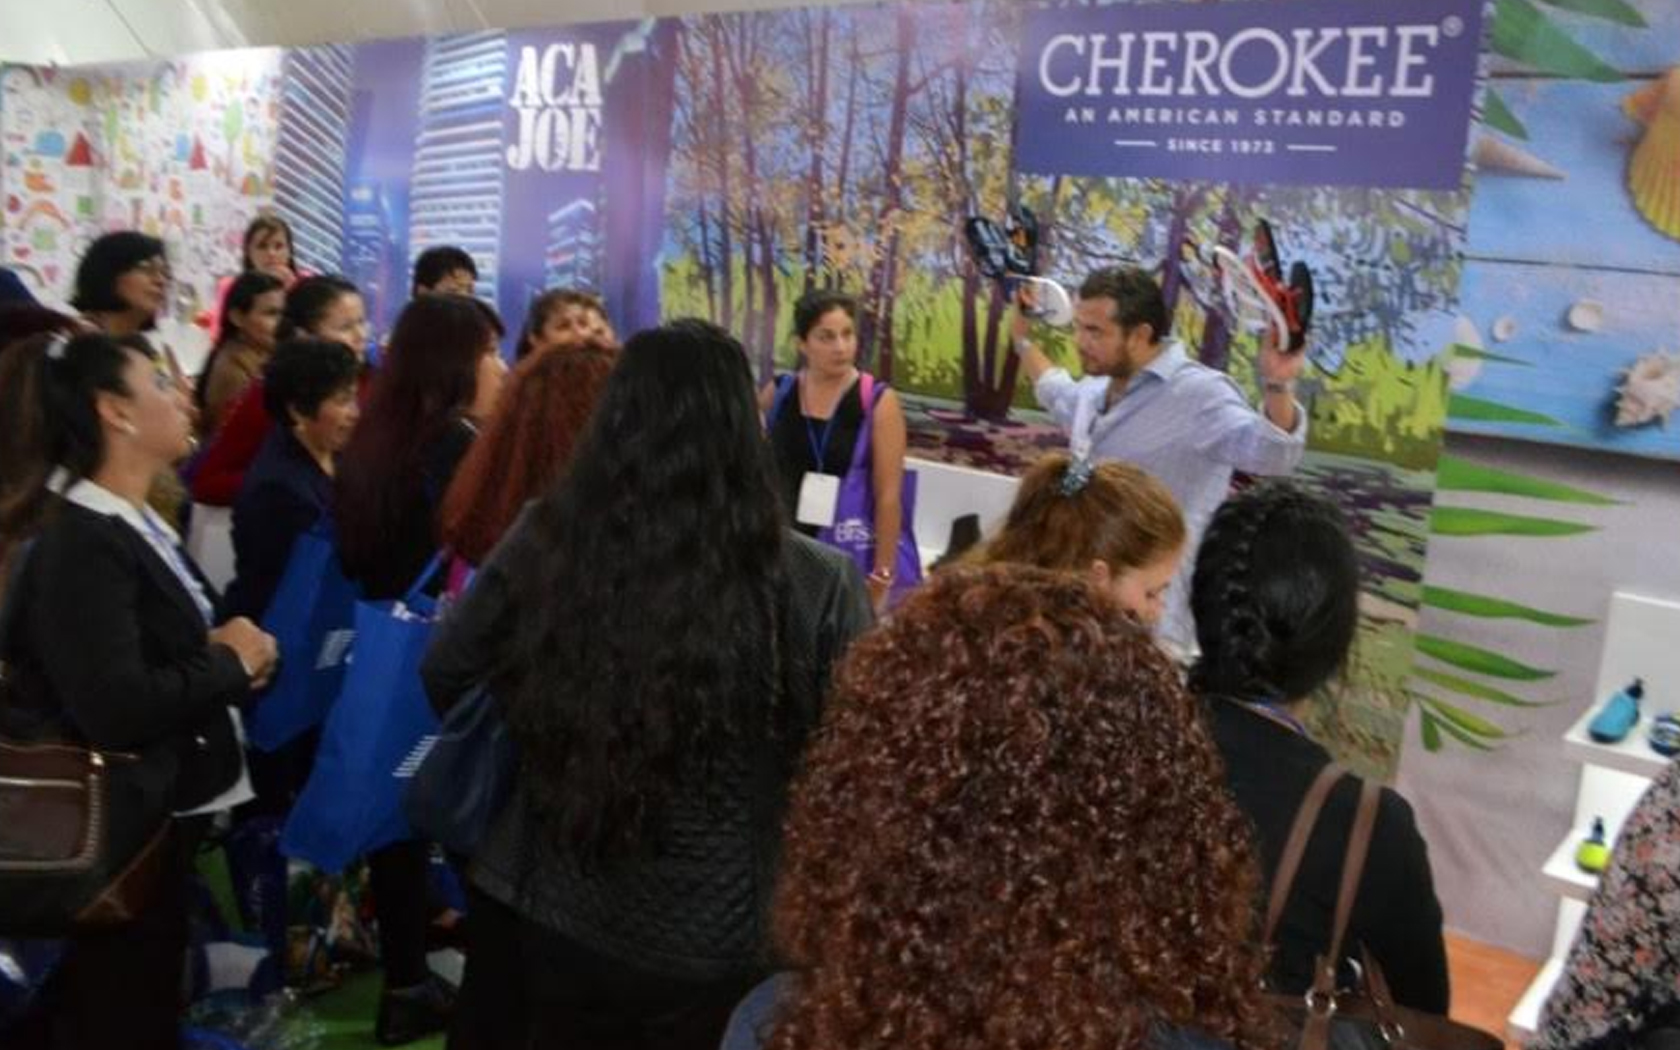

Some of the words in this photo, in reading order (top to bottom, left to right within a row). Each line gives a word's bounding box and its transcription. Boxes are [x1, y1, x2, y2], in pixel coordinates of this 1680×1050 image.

[508, 42, 603, 107] ACA
[506, 106, 602, 171] JOE
[1064, 108, 1095, 123] AN
[1107, 109, 1239, 125] AMERICAN
[1253, 109, 1406, 128] STANDARD
[1166, 138, 1222, 153] SINCE
